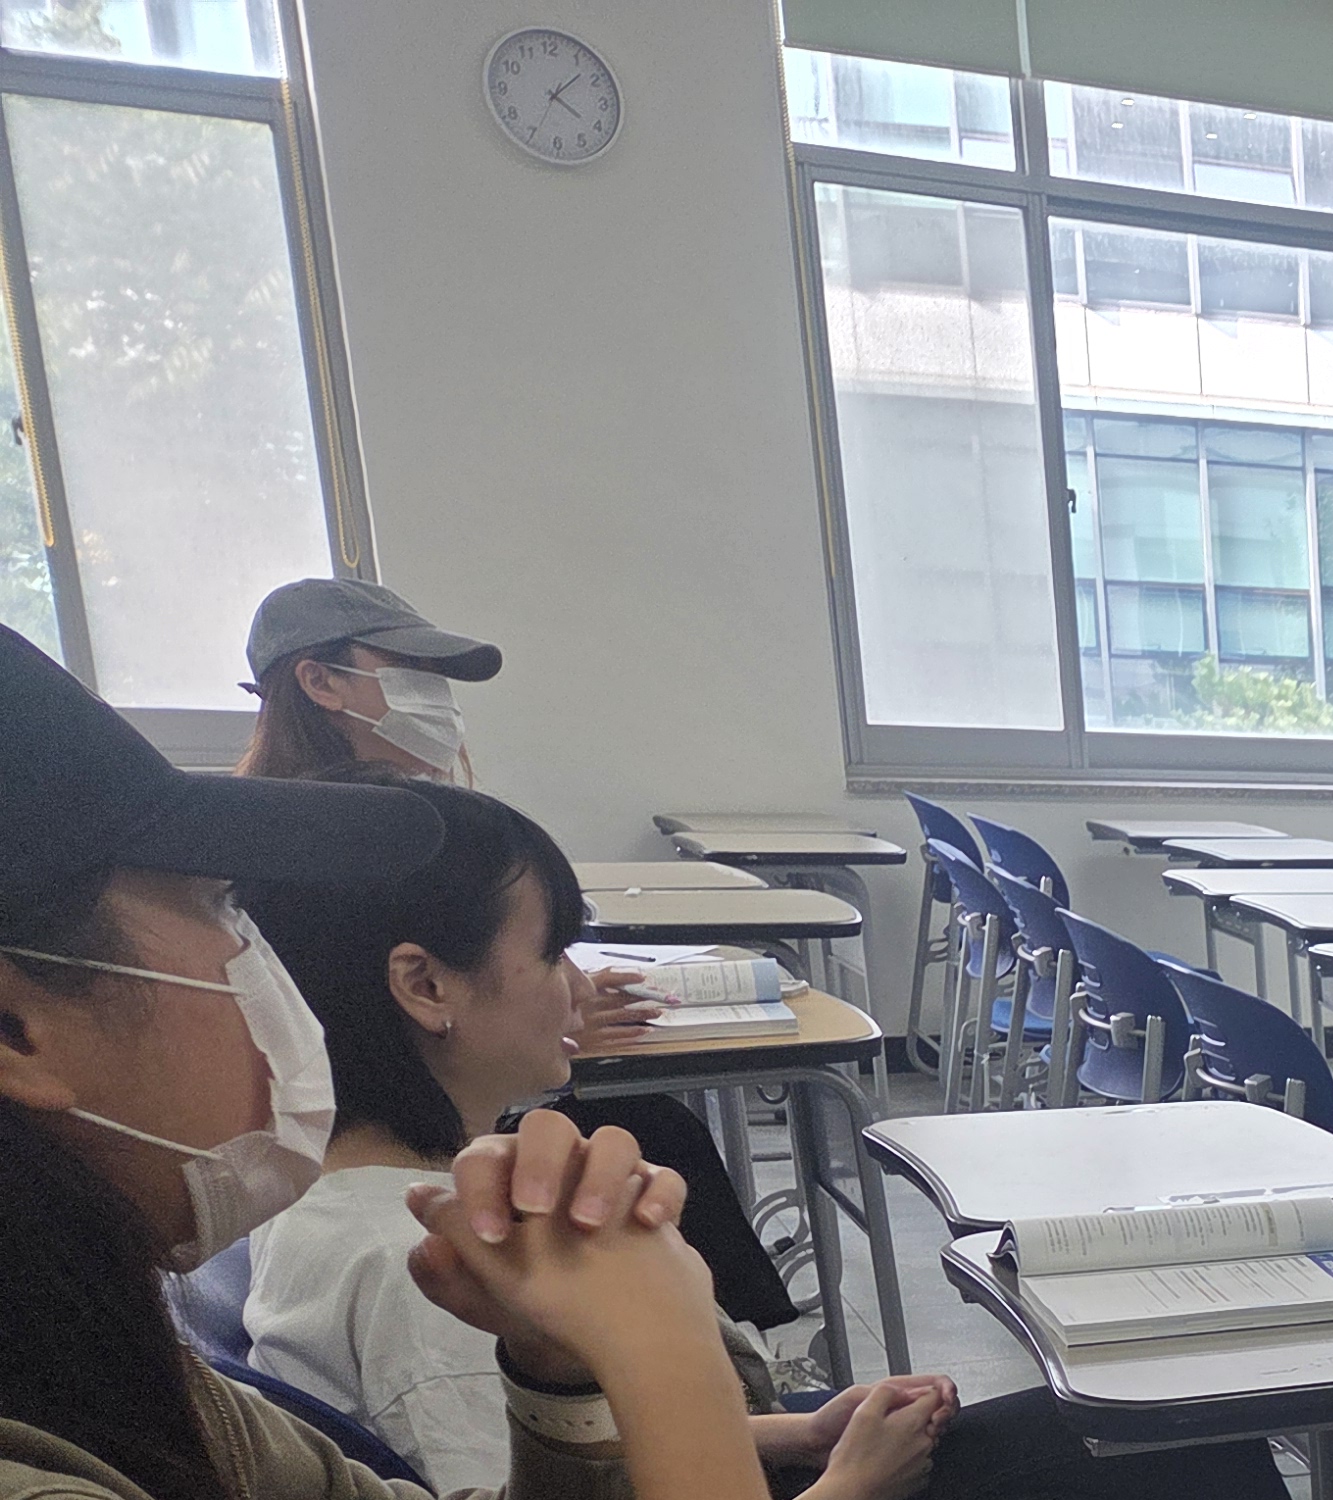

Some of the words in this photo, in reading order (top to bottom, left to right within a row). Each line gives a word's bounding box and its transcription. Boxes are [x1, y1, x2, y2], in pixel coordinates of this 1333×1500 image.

[519, 45, 534, 59] 11
[541, 41, 559, 57] 12
[502, 60, 521, 75] 10
[590, 73, 601, 88] 2
[498, 81, 508, 96] 9
[598, 97, 608, 112] 3
[507, 105, 518, 120] 8
[593, 119, 602, 132] 4
[526, 125, 537, 144] 7
[577, 133, 587, 148] 5
[553, 135, 563, 151] 6
